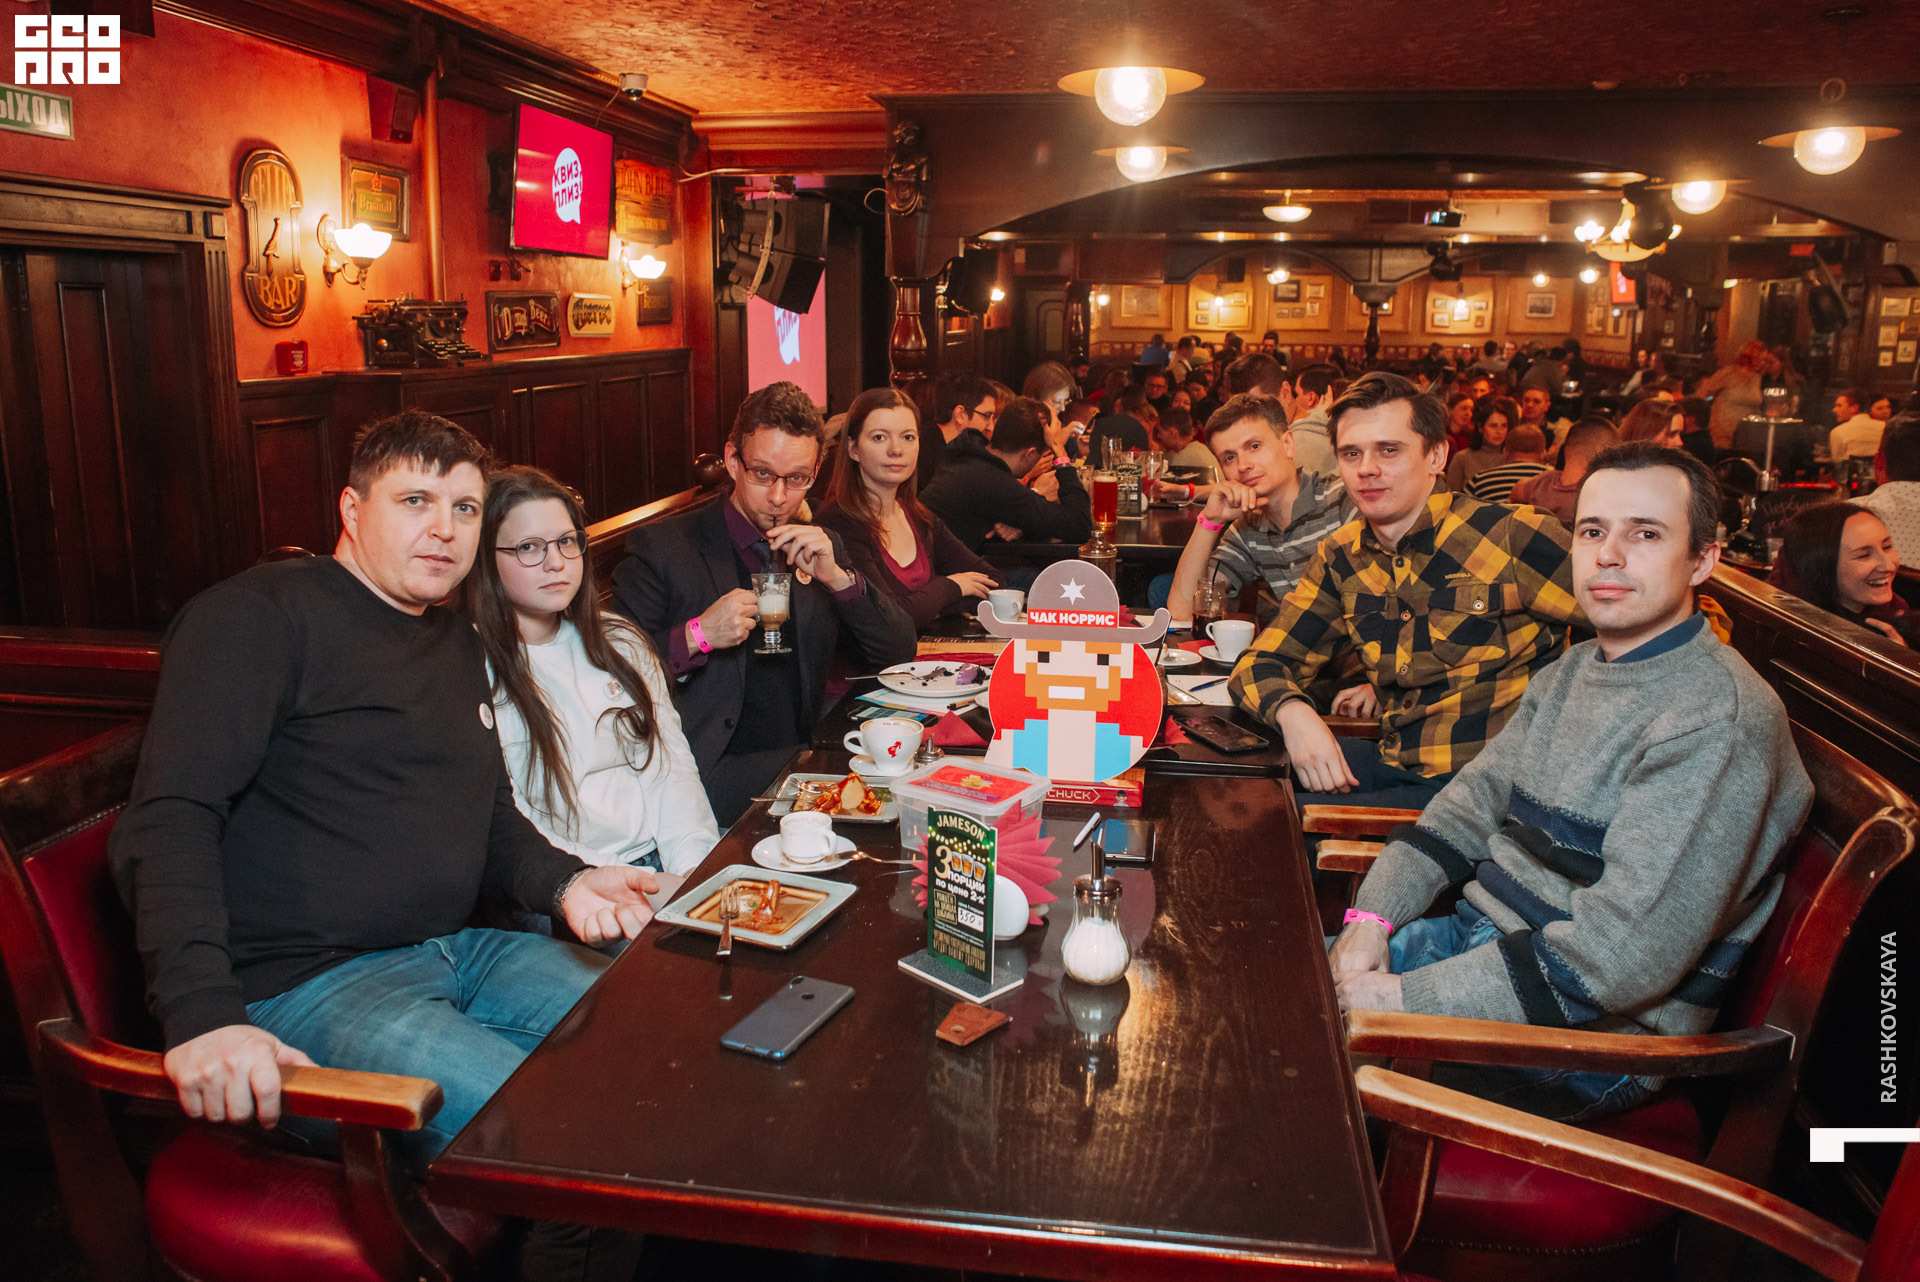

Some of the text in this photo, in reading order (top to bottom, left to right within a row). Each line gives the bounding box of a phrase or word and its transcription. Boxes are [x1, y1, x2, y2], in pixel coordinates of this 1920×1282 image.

[258, 275, 297, 310] BAR
[1029, 611, 1115, 627] ЧАК НОРРИС
[1047, 789, 1091, 800] CHUCK
[936, 814, 986, 842] JAMESON
[934, 845, 953, 879] 3
[935, 878, 946, 888] по
[948, 883, 969, 898] цене
[947, 870, 986, 894] ПОРЦИИ
